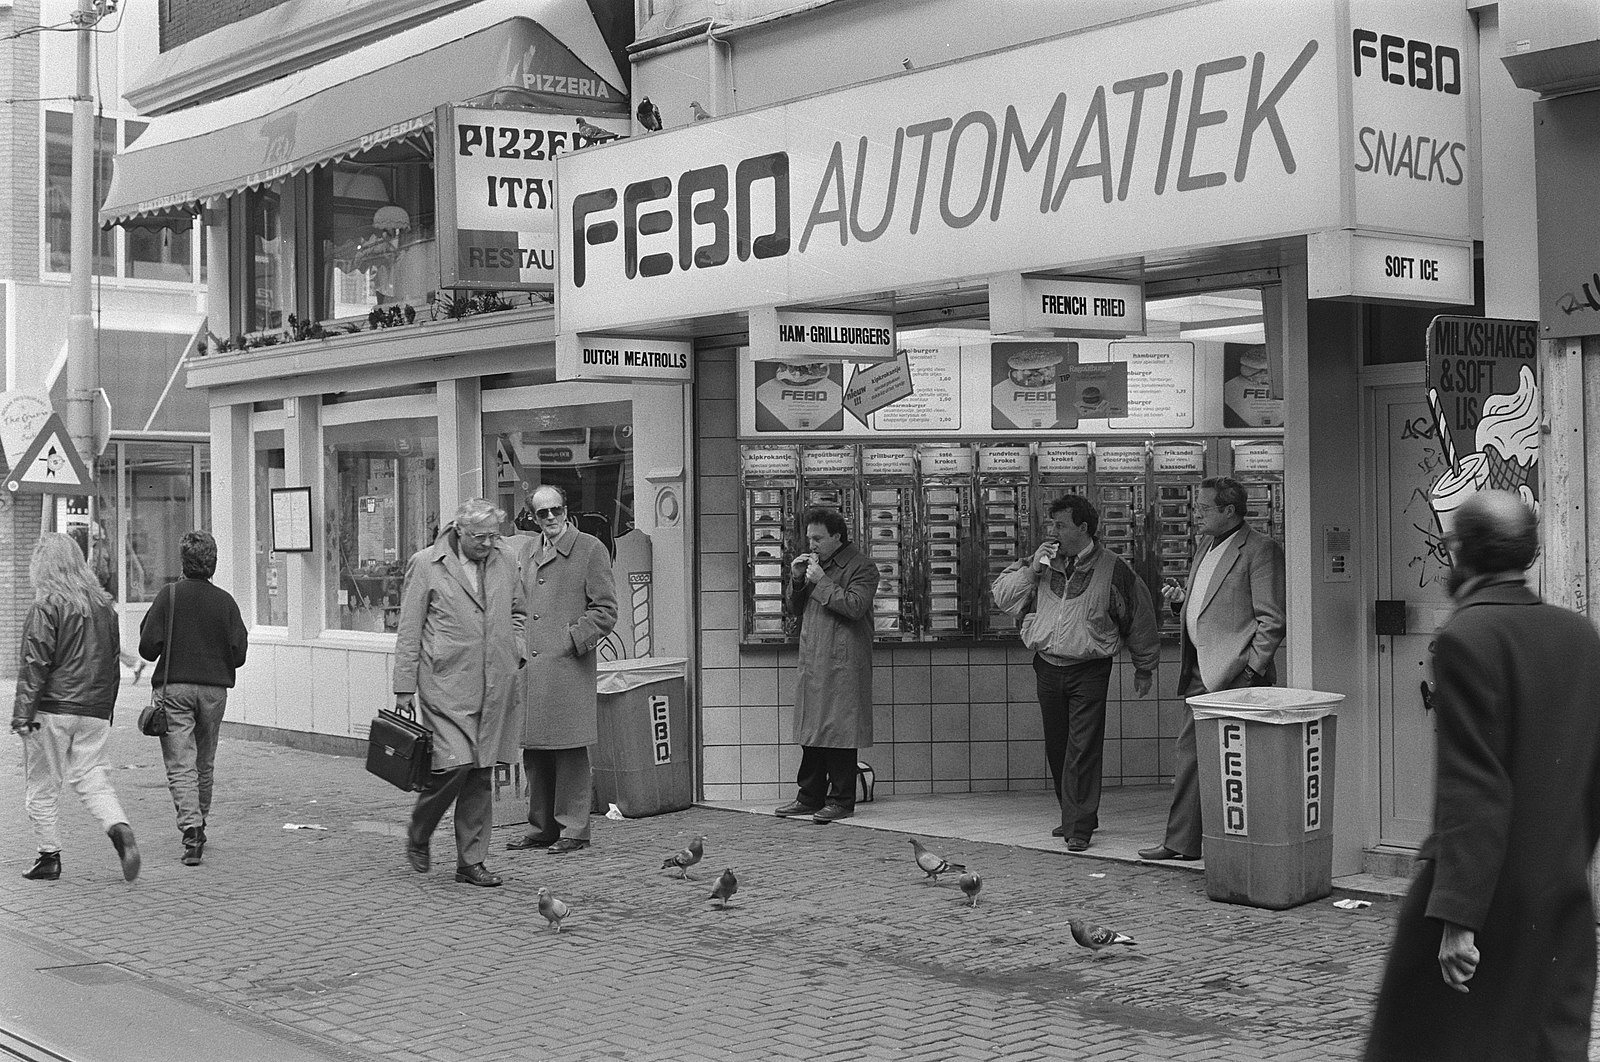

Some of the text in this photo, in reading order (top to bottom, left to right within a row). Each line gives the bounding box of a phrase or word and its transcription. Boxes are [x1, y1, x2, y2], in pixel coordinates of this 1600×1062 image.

[1353, 28, 1461, 95] FEBO
[522, 73, 609, 99] PIZZERIA
[360, 117, 424, 148] PIZZERIA
[458, 124, 631, 161] PIZZE
[798, 39, 1319, 252] AUTOMATIEK
[1354, 126, 1466, 186] SNACKS
[487, 175, 554, 210] ITA
[572, 151, 790, 288] FEBO
[1385, 255, 1439, 281] SOFT ICE
[1042, 294, 1126, 318] FRENCH FRIED
[779, 325, 890, 346] HAM-GRILLBURGERS
[1435, 320, 1537, 359] MILKSHAKES
[583, 348, 687, 369] DUTCH MEATROLLS
[1440, 358, 1496, 393] & SOFT
[781, 389, 828, 401] FEBO
[847, 386, 866, 401] nieuw
[1059, 374, 1071, 382] TIP
[1455, 396, 1478, 431] IJS
[749, 453, 792, 461] kipkrokantje
[652, 695, 670, 762] EBO
[1223, 724, 1245, 831] FEBO
[1306, 720, 1320, 827] FEBO
